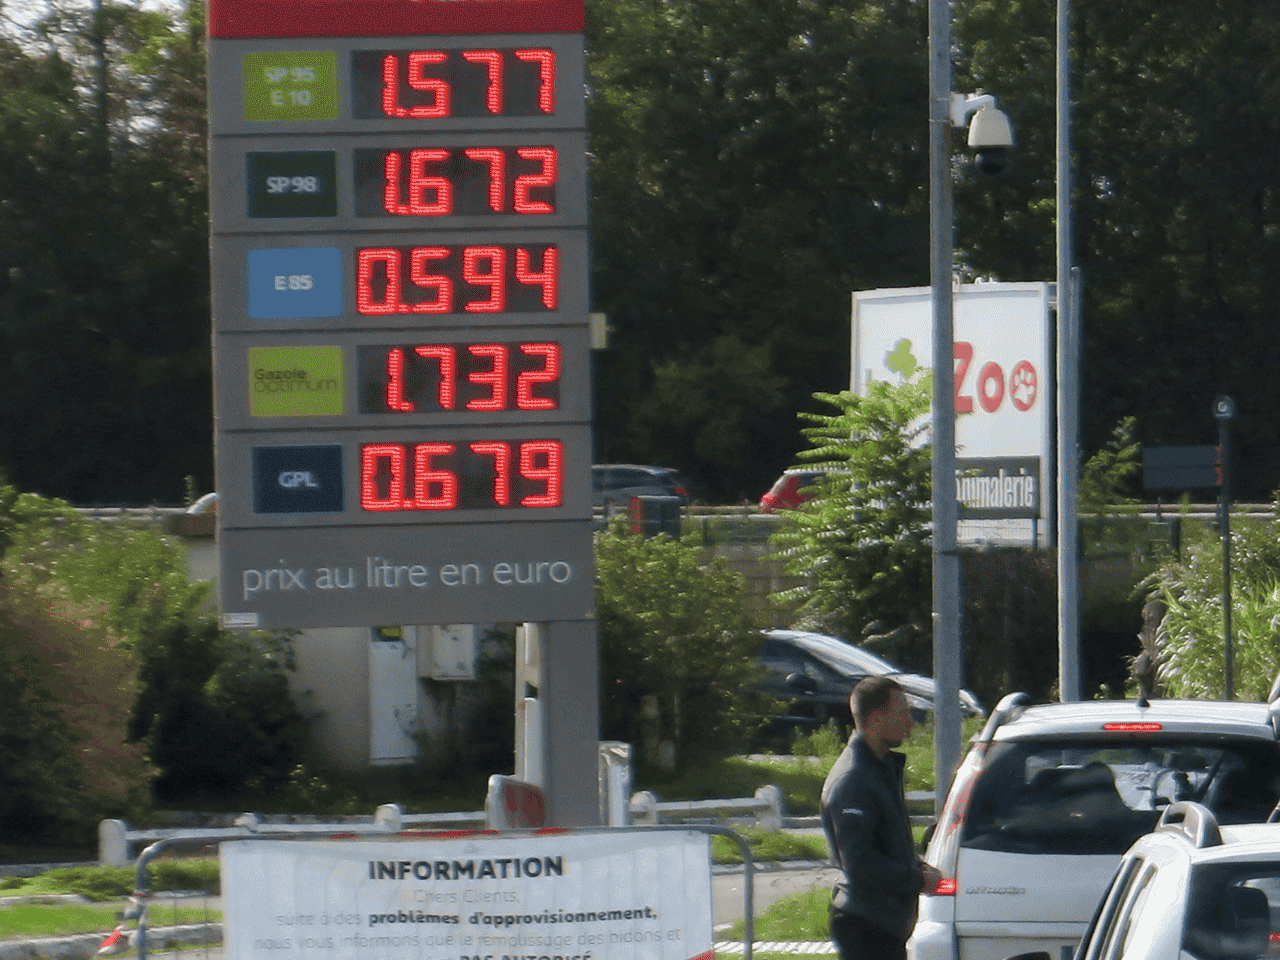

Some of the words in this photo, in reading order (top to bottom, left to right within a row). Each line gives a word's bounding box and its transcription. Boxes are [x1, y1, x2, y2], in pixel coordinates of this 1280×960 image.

[382, 49, 556, 118] 1.577
[385, 147, 559, 216] 1.672
[356, 245, 556, 315] 0.594
[254, 367, 307, 381] Gazole
[386, 342, 560, 411] 1.732
[278, 471, 319, 488] GPL
[360, 440, 564, 510] 0.679
[242, 561, 306, 600] prix
[316, 564, 354, 590] au
[366, 556, 429, 589] litre
[441, 561, 482, 586] en
[493, 559, 571, 585] euro
[368, 855, 564, 881] INFORMATION
[413, 889, 458, 903] Chers
[334, 911, 364, 926] des
[369, 907, 460, 928] problèmes
[424, 933, 455, 949] que
[477, 928, 572, 950] remplissage
[577, 927, 605, 947] des
[610, 927, 662, 945] bidons
[666, 927, 682, 942] et
